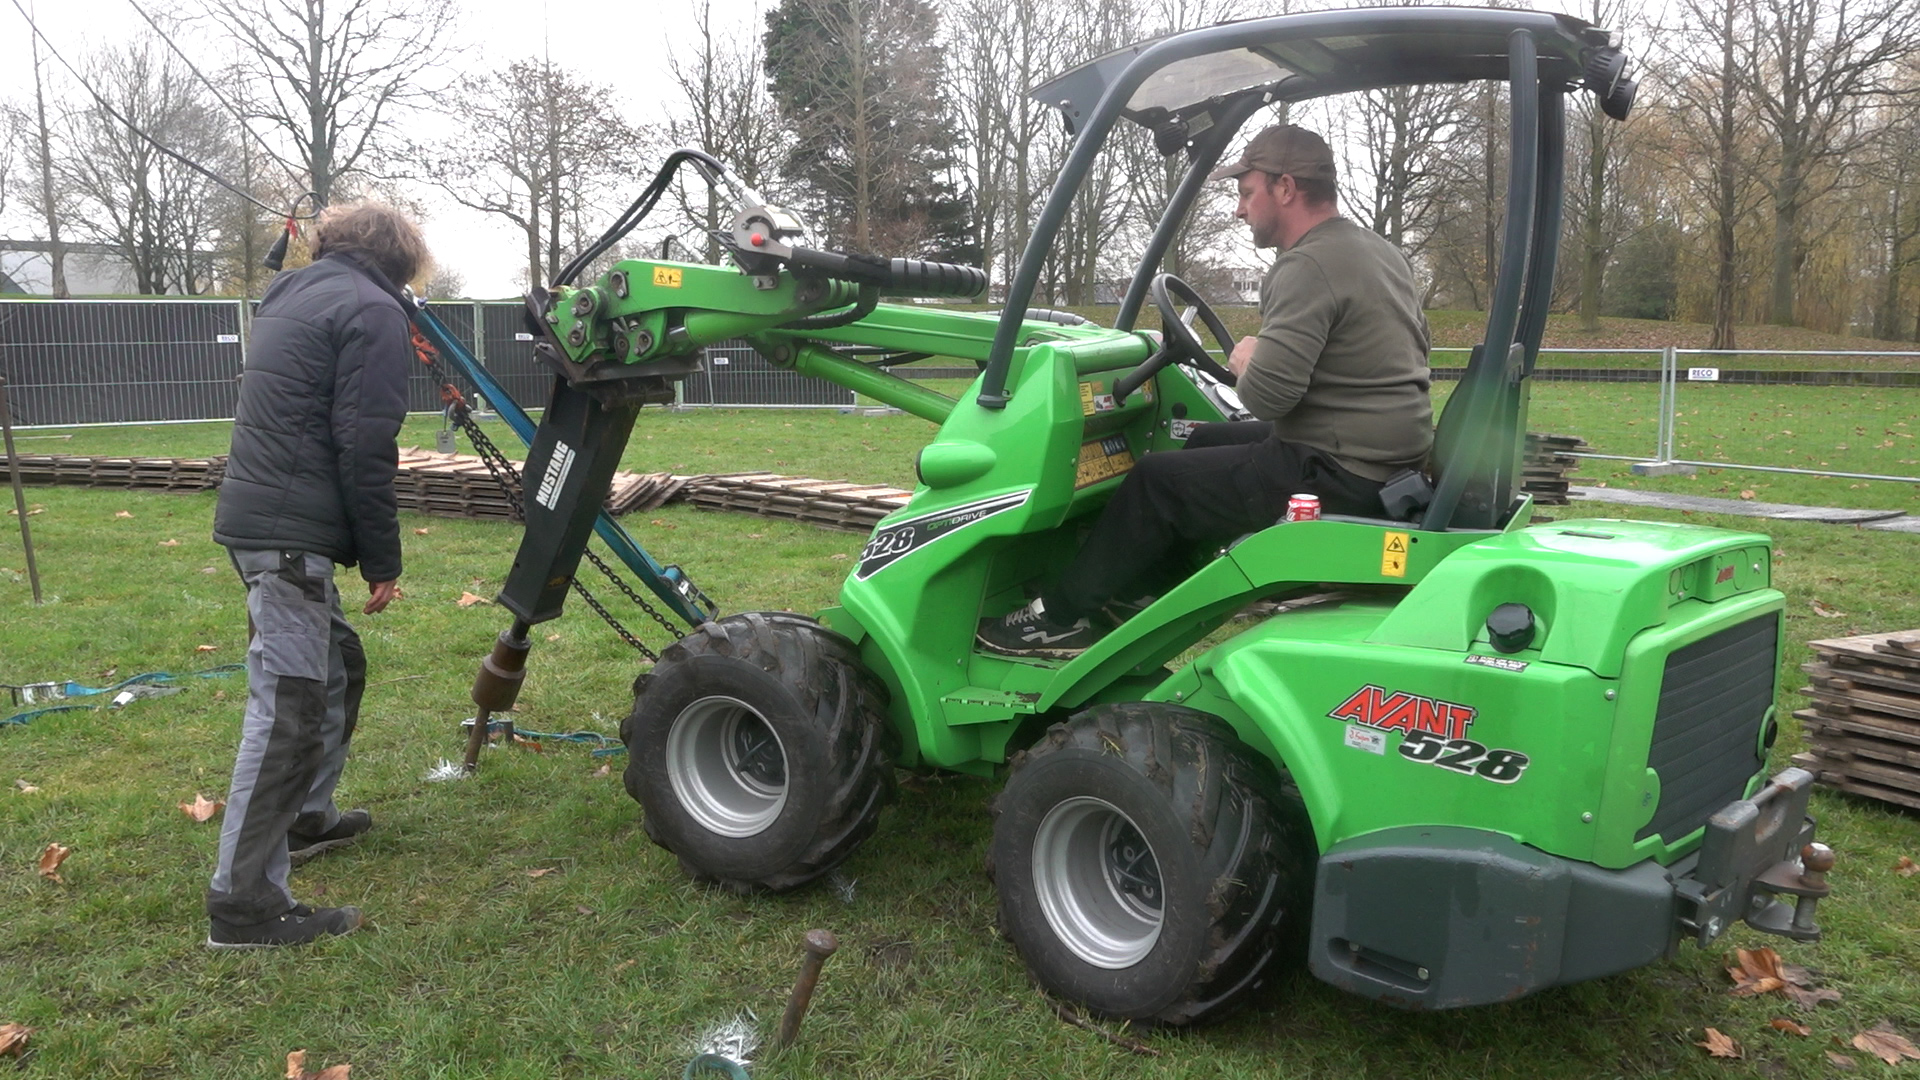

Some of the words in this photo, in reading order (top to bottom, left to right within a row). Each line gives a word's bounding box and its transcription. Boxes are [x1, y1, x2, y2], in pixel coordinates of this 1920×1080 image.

[1692, 369, 1713, 377] RECO
[535, 440, 569, 507] MUSTANG
[926, 509, 987, 531] OPTIDRIVE
[859, 526, 915, 563] 528
[1325, 683, 1476, 740] AVANT
[1398, 728, 1530, 784] 528
